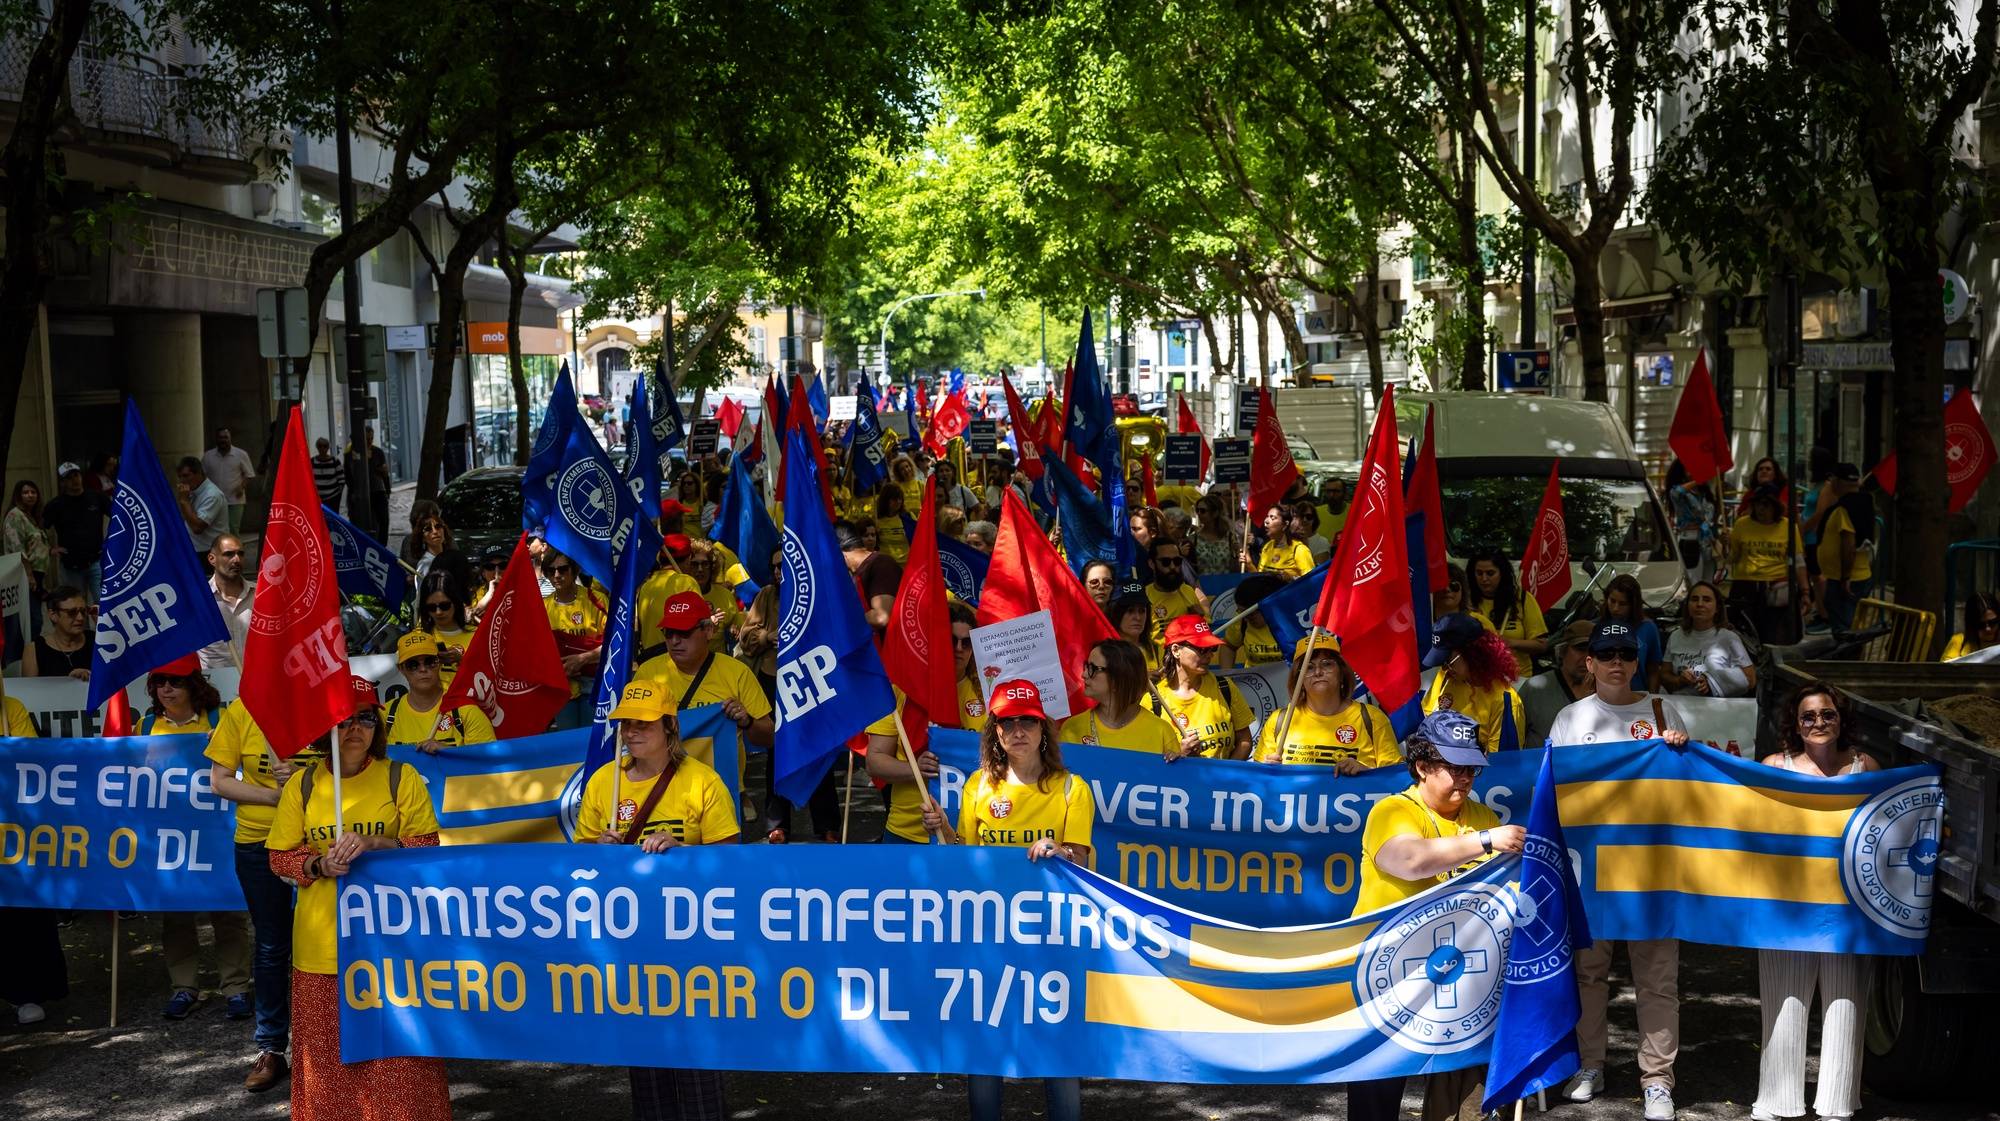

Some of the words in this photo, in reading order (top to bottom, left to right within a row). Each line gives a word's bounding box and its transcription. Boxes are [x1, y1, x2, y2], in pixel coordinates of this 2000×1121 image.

[482, 331, 505, 342] mob
[1513, 357, 1534, 383] P
[117, 489, 150, 582] PORTUGUESES
[485, 545, 502, 554] SEP
[1123, 583, 1143, 593] SEP
[669, 603, 690, 614] SEP
[95, 582, 178, 664] SEP
[980, 631, 1009, 644] ESTAMOS
[1010, 622, 1046, 637] CANSADOS
[1602, 624, 1629, 636] SEP
[404, 635, 427, 648] SEP
[994, 640, 1014, 650] TANTA
[995, 644, 1032, 659] PALMINHAS
[625, 688, 653, 701] SEP
[1006, 687, 1034, 700] SEP
[1205, 721, 1230, 735] DIA
[16, 763, 78, 806] DE
[96, 765, 229, 811] ENFE
[982, 829, 1017, 844] ESTE
[1023, 829, 1056, 844] DIA
[1862, 824, 1882, 855] DOS
[108, 827, 138, 869] O
[156, 828, 213, 872] DL
[1117, 842, 1303, 895] MUDAR
[1323, 852, 1354, 895] O
[1861, 862, 1911, 920] SINDICATO
[340, 868, 639, 939] ADMISSÃO
[661, 886, 736, 941] DE
[759, 888, 1171, 960] ENFERMEIROS
[1398, 896, 1500, 938] ENFERMEIROS
[1374, 945, 1396, 972] DOS
[344, 957, 527, 1012] QUERO
[546, 962, 757, 1020] MUDAR
[779, 966, 816, 1020] O
[837, 966, 911, 1022] DL
[934, 963, 1071, 1029] 71/19
[1377, 976, 1435, 1037] SINDICATO
